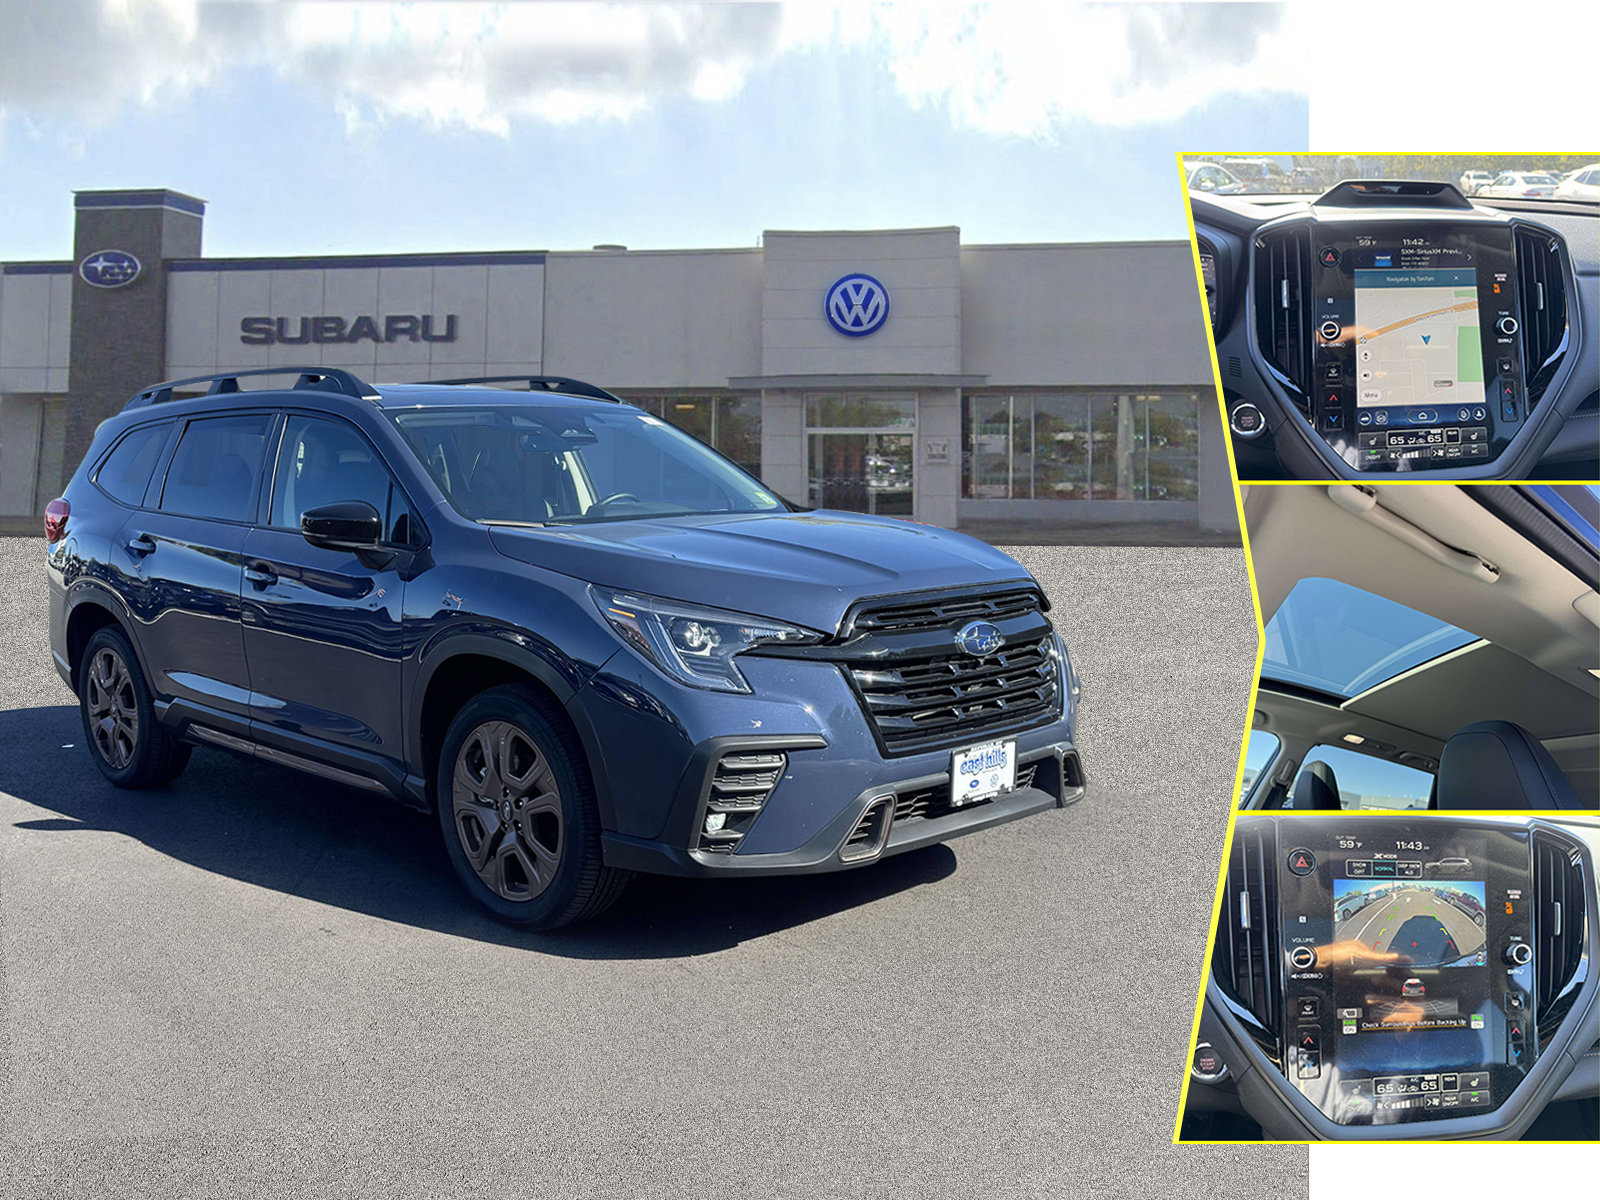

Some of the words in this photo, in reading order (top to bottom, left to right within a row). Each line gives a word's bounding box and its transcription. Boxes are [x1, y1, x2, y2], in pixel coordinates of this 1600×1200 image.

[1402, 238, 1424, 246] 11:42
[240, 314, 458, 345] SUBARU
[1390, 436, 1404, 445] 65
[1427, 434, 1442, 443] 65
[1339, 840, 1355, 849] 59
[1396, 841, 1423, 851] 11:43
[1376, 1084, 1394, 1094] 65
[1420, 1081, 1438, 1091] 65
